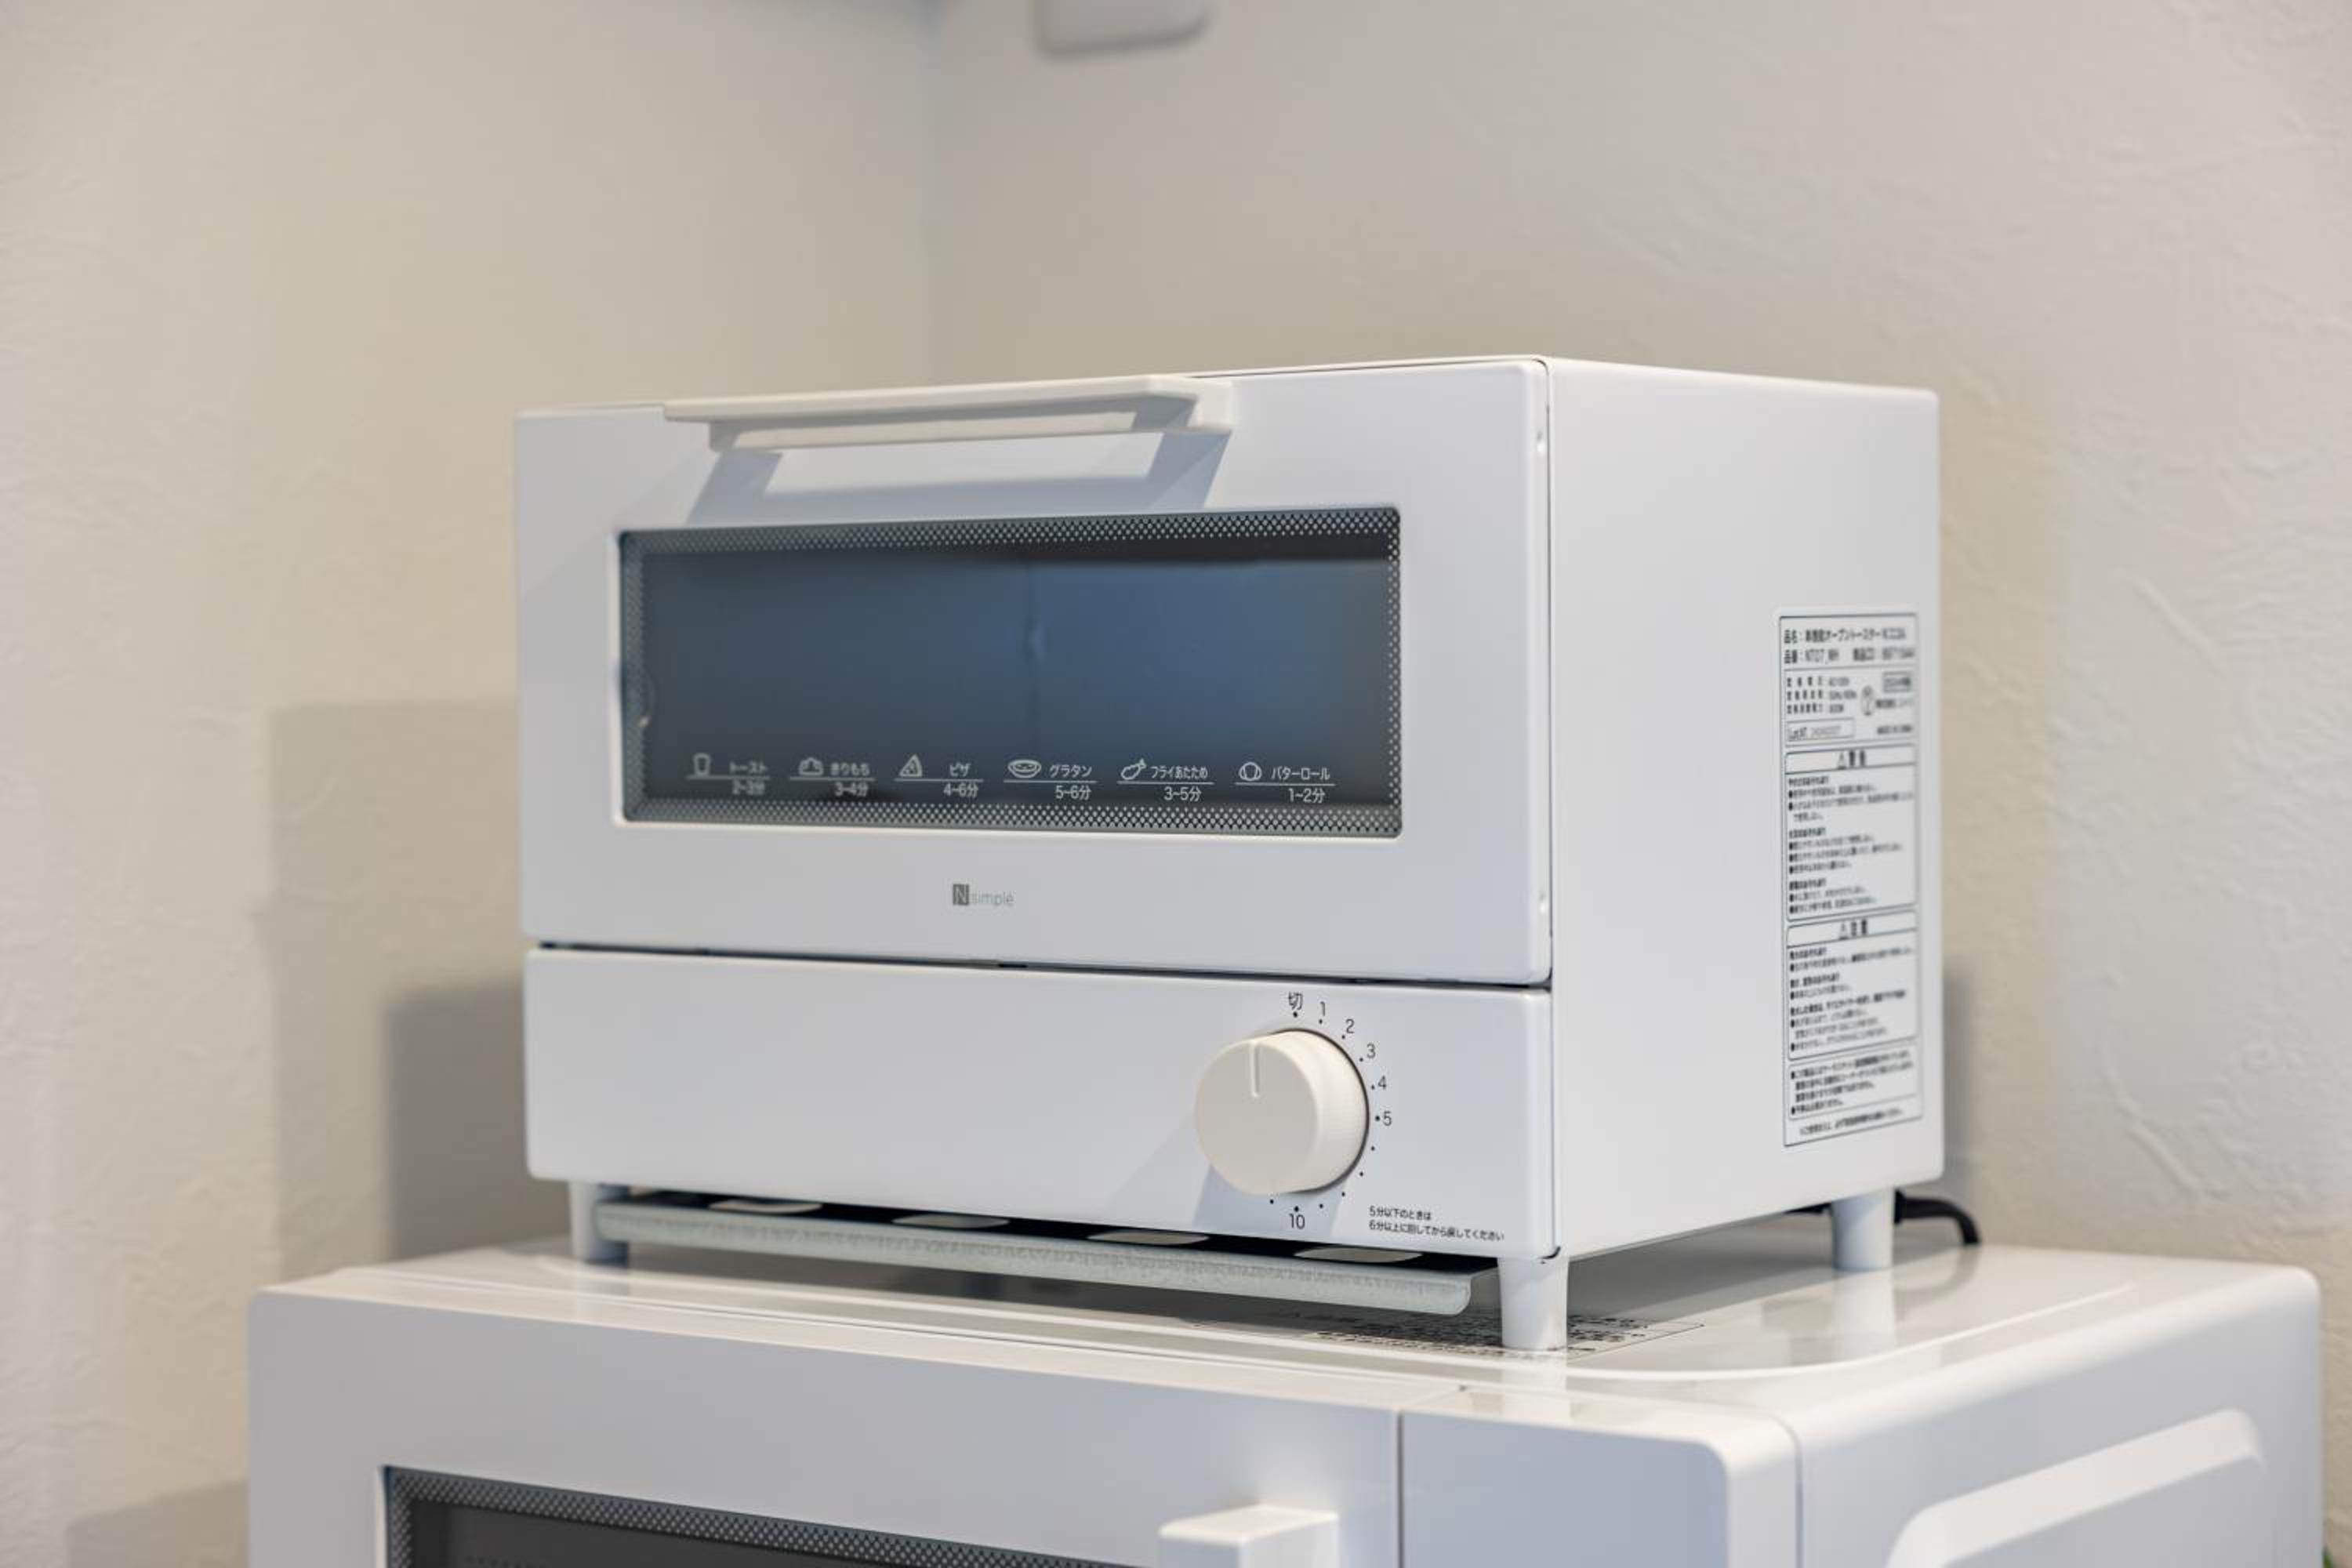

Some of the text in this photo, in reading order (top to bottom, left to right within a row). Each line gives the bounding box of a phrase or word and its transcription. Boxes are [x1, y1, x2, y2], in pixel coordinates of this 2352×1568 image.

[1049, 764, 1092, 778] グラタン
[1150, 764, 1208, 779] フライあたため
[1270, 766, 1330, 780] バターロール
[1288, 992, 1303, 1010] 切
[1320, 1001, 1326, 1016] 1
[1345, 1018, 1355, 1033] 2
[1367, 1044, 1376, 1058] 3
[1377, 1076, 1387, 1090] 4
[1383, 1111, 1392, 1126] 5
[1369, 1205, 1432, 1221] 5分以下のときは
[1289, 1213, 1305, 1229] 10
